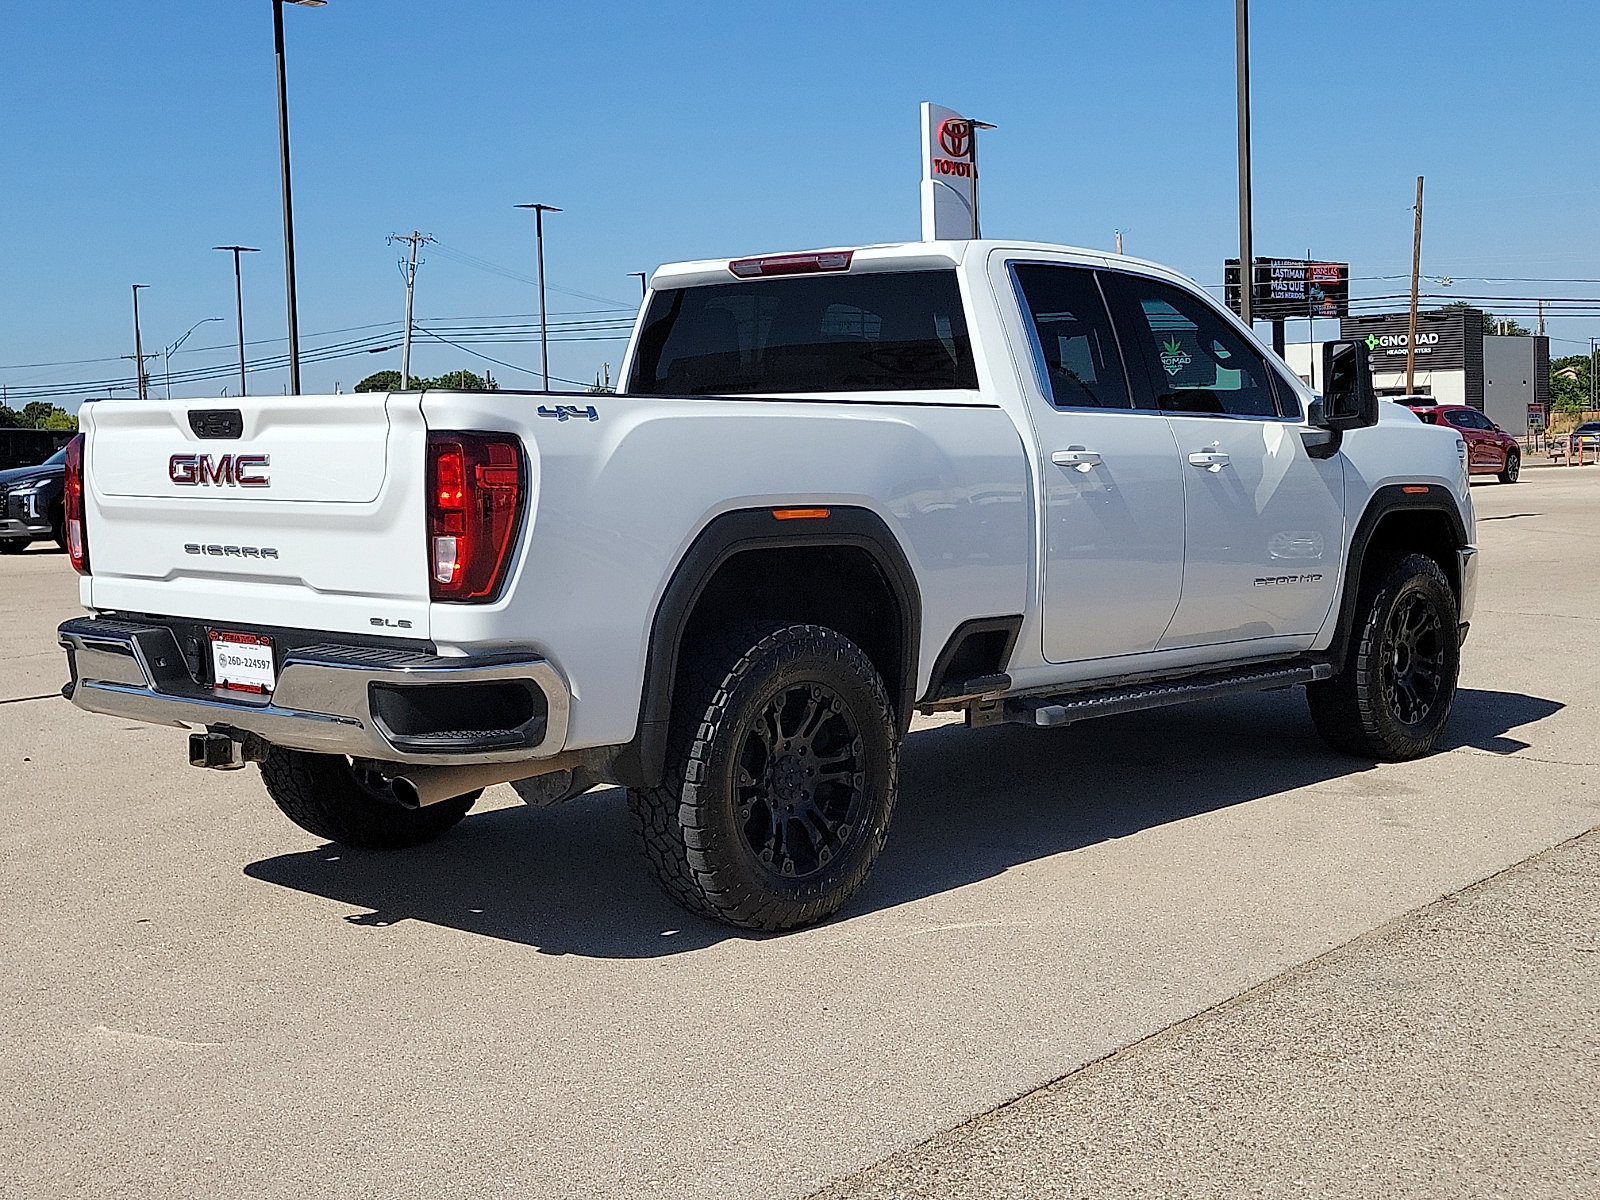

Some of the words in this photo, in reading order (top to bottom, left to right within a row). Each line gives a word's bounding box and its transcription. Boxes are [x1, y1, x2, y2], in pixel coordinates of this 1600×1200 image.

[1270, 268, 1305, 279] LASTIMAN
[1288, 281, 1304, 292] QUE
[1270, 291, 1275, 299] A
[169, 453, 271, 488] GMC
[184, 543, 279, 559] SIERRA
[369, 617, 413, 629] SLE
[227, 655, 271, 670] 26D-224597
